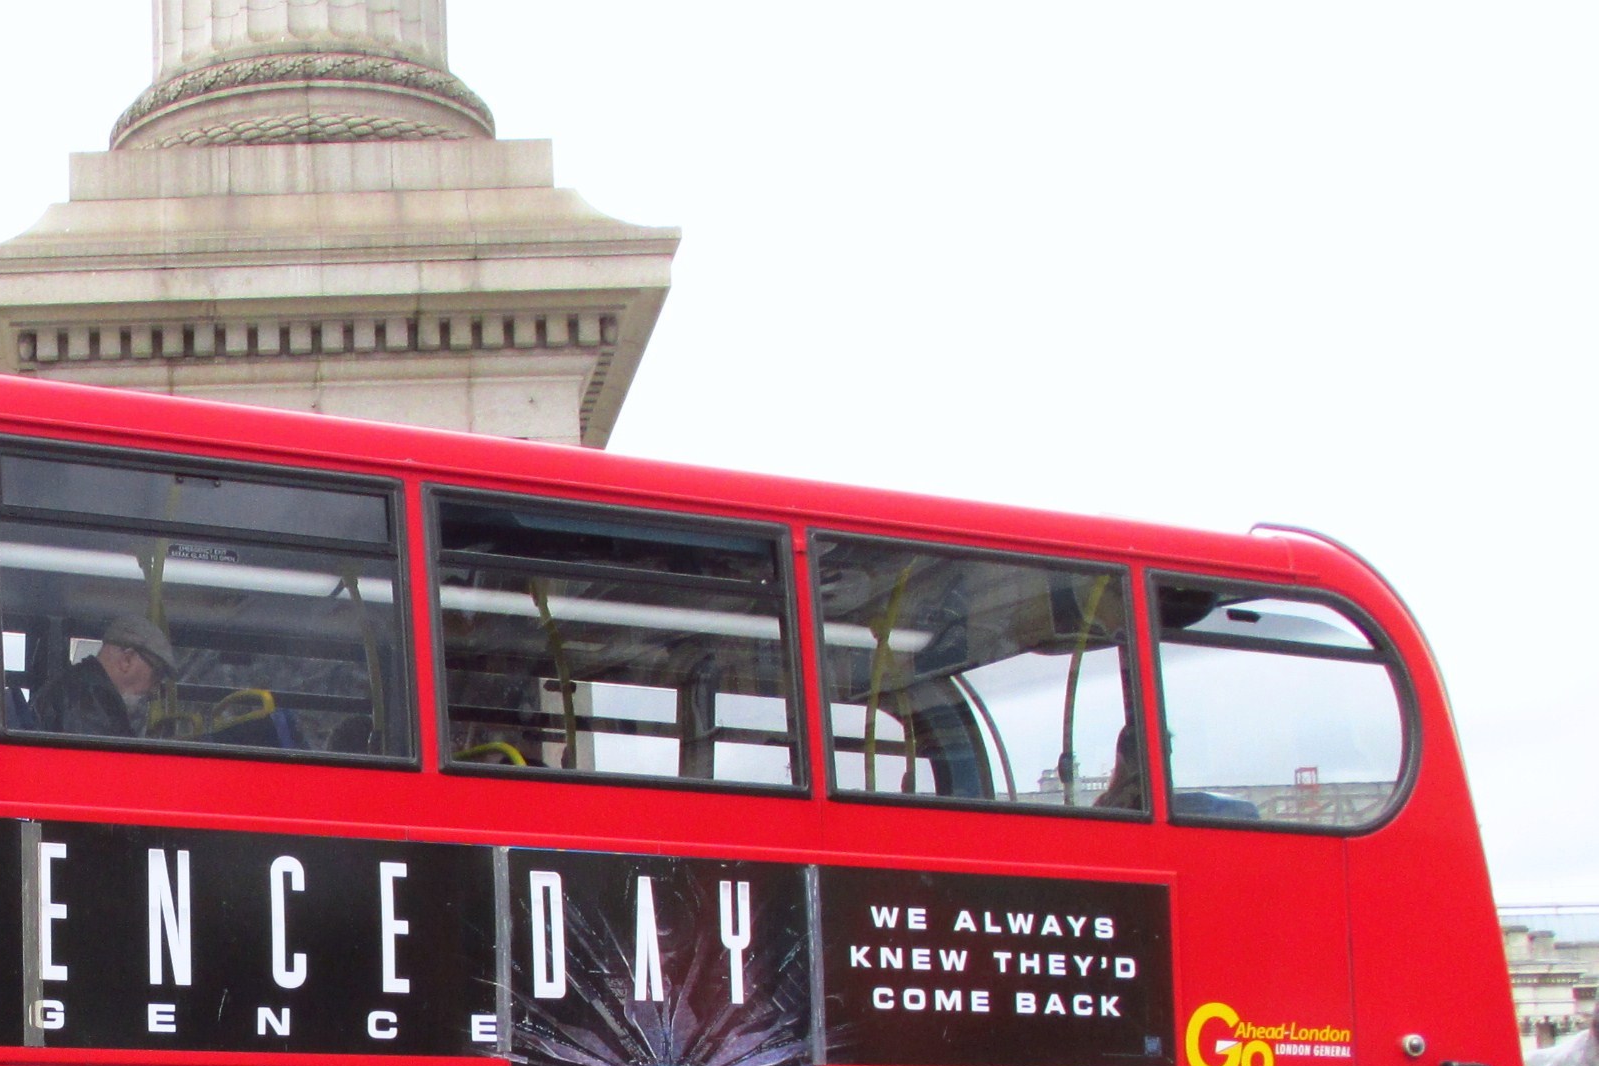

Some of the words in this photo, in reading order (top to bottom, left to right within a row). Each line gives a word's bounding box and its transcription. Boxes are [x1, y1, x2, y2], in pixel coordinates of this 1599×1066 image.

[529, 870, 751, 1005] DAY
[870, 905, 928, 930] WE
[954, 909, 1115, 939] ALWAYS
[850, 945, 968, 972] KNEW
[993, 950, 1137, 980] THEY'D
[872, 987, 991, 1014] COME
[1015, 992, 1121, 1018] BACK
[1234, 1021, 1351, 1043] Ahead-London
[1275, 1043, 1311, 1056] LONDON
[1313, 1045, 1351, 1058] GENERAL
